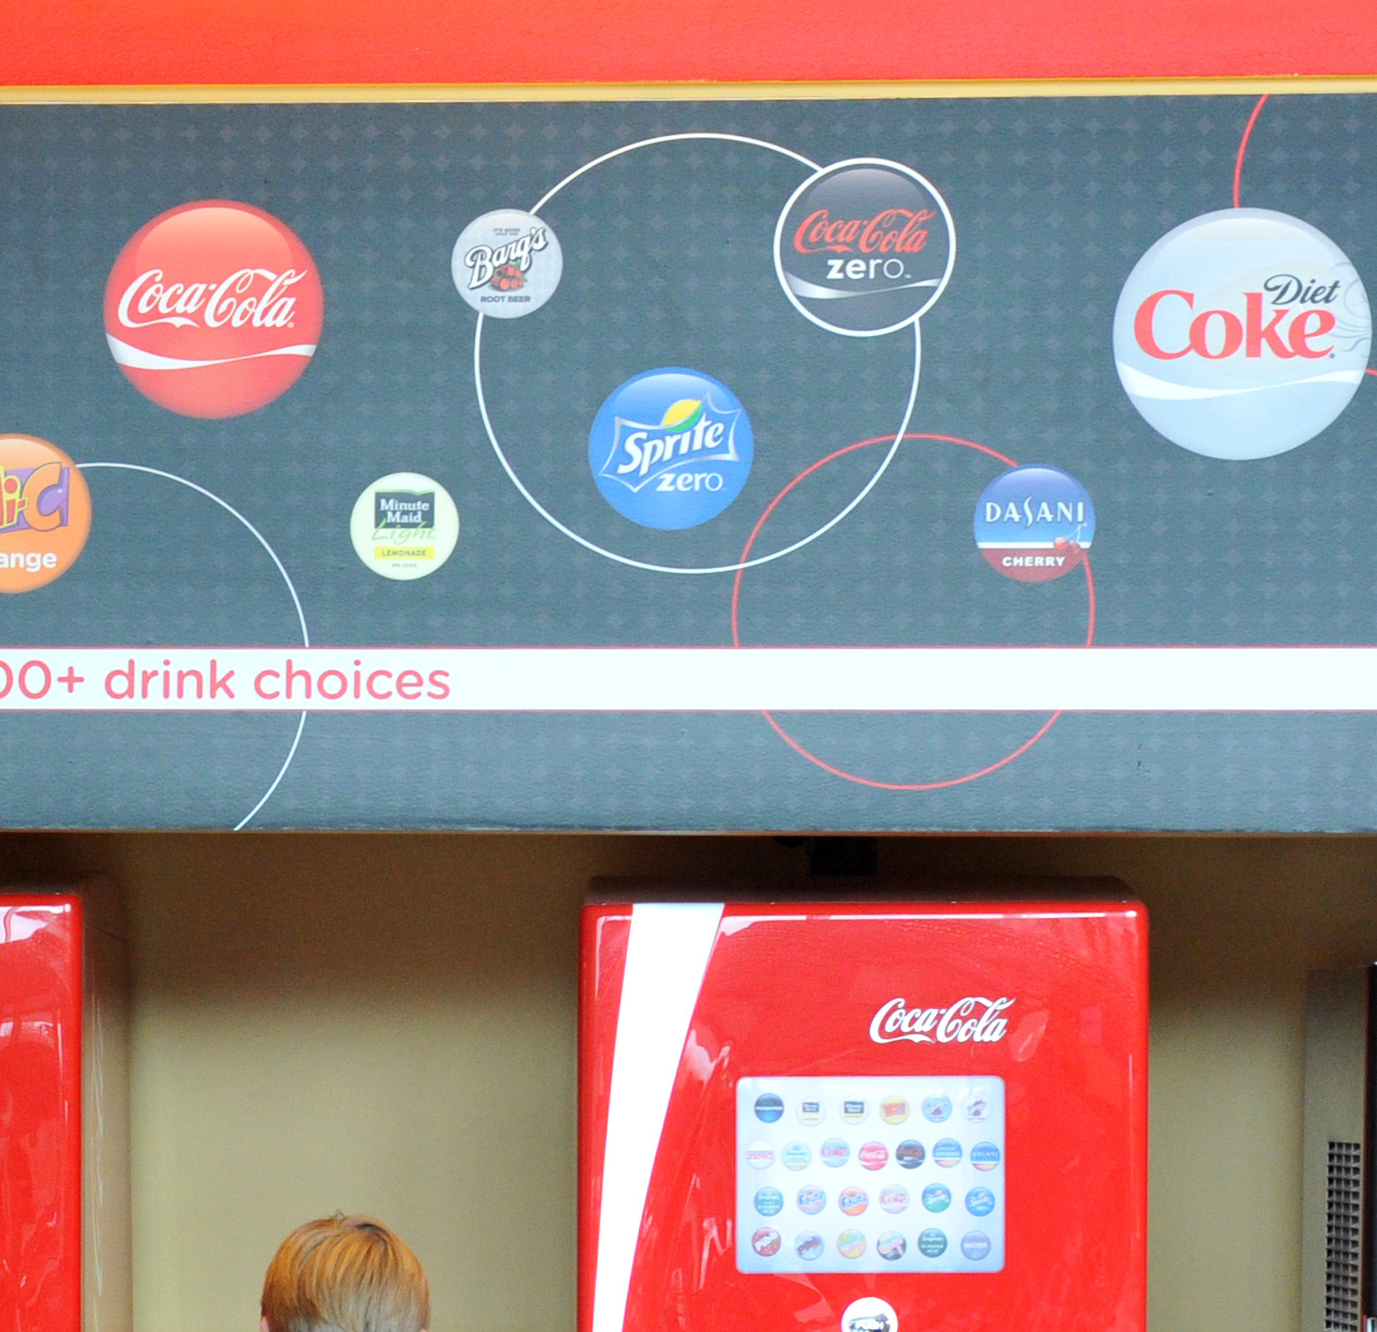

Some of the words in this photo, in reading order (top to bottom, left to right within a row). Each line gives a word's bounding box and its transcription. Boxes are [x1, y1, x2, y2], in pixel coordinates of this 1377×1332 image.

[794, 208, 935, 255] Coca-Cola
[464, 227, 549, 290] Barq's
[826, 256, 906, 281] zero
[117, 268, 308, 330] Coca-Cola
[1263, 273, 1340, 308] Diet
[1134, 289, 1335, 361] Coke
[616, 416, 726, 477] Sprite
[656, 469, 724, 493] zero
[380, 498, 430, 511] Minute
[387, 511, 422, 523] Maid
[984, 497, 1085, 526] DASANI
[1002, 556, 1066, 568] CHERRY
[104, 660, 235, 701] drink
[253, 660, 451, 701] choices
[869, 996, 1016, 1045] Coca-Cola
